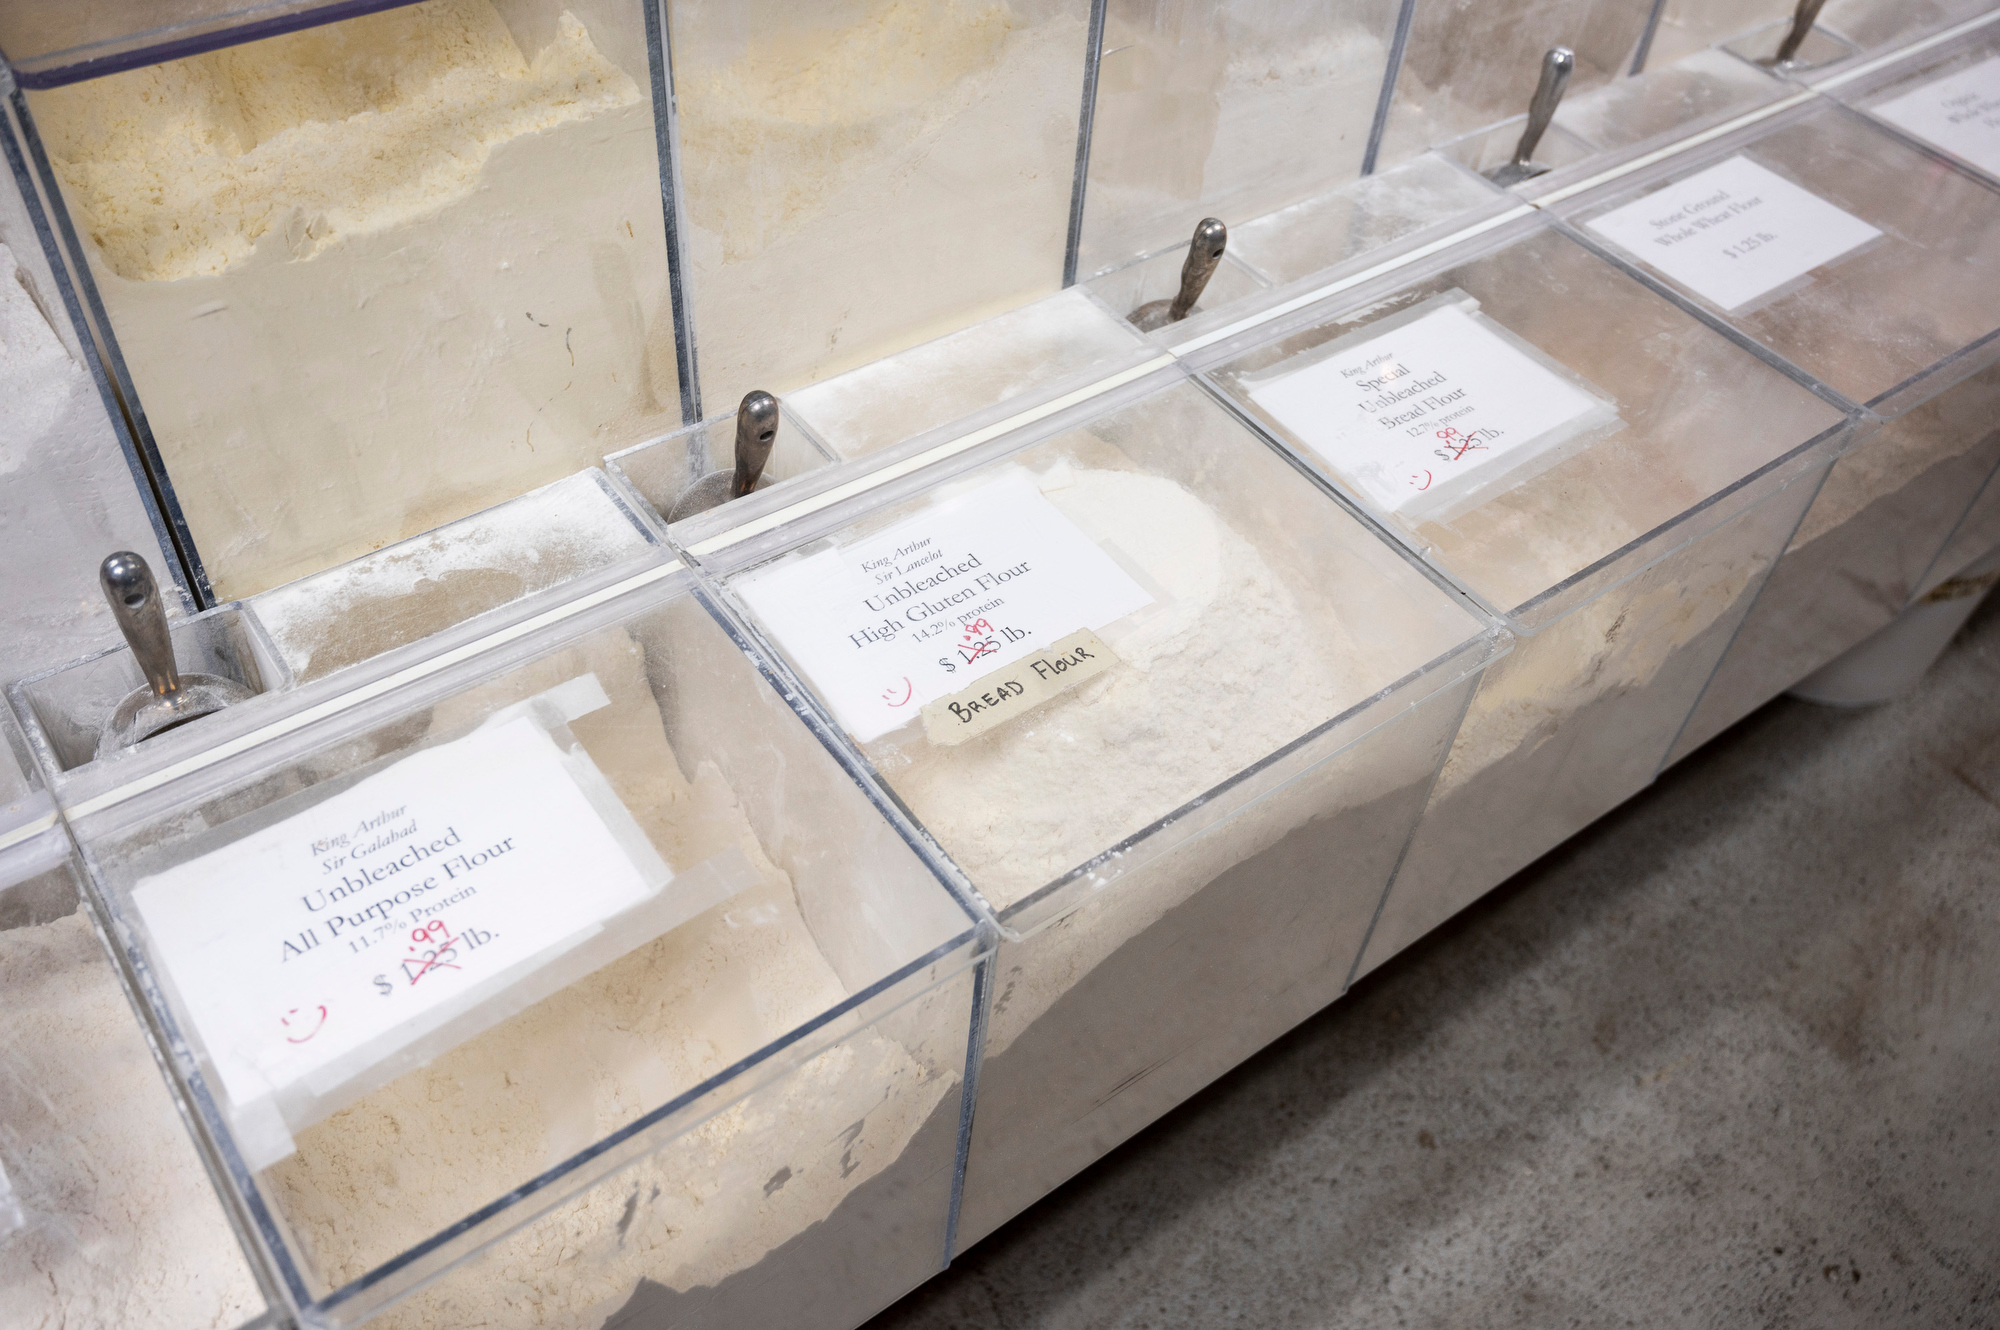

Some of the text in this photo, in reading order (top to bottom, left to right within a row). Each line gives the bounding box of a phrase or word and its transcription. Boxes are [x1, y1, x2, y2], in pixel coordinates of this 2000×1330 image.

[1650, 190, 1729, 229] Stone Ground
[1654, 196, 1763, 246] Whole Wheat Flour
[1340, 352, 1394, 379] King Arthur
[1356, 364, 1410, 392] Special
[1357, 371, 1447, 413] Unbleached
[1378, 386, 1467, 430] Bread Flour
[1439, 404, 1474, 427] protein
[1434, 449, 1449, 462] $
[861, 536, 932, 573] King Arthur
[874, 548, 943, 585] Sir Lancelot
[848, 560, 1032, 649] High Gluten Flour
[863, 553, 982, 613] Unbleached
[911, 595, 1004, 643] 14.2% protein
[939, 658, 956, 674] $
[1001, 625, 1032, 645] lb.
[948, 680, 1024, 724] BREAD
[310, 805, 407, 857] King Arthur
[322, 819, 418, 876] Sir Galahad
[301, 826, 462, 913] Unbleached
[280, 834, 516, 962] All Purpose Flour
[348, 884, 477, 954] 11.7% Protein
[373, 973, 394, 998] $
[461, 923, 499, 954] lb.
